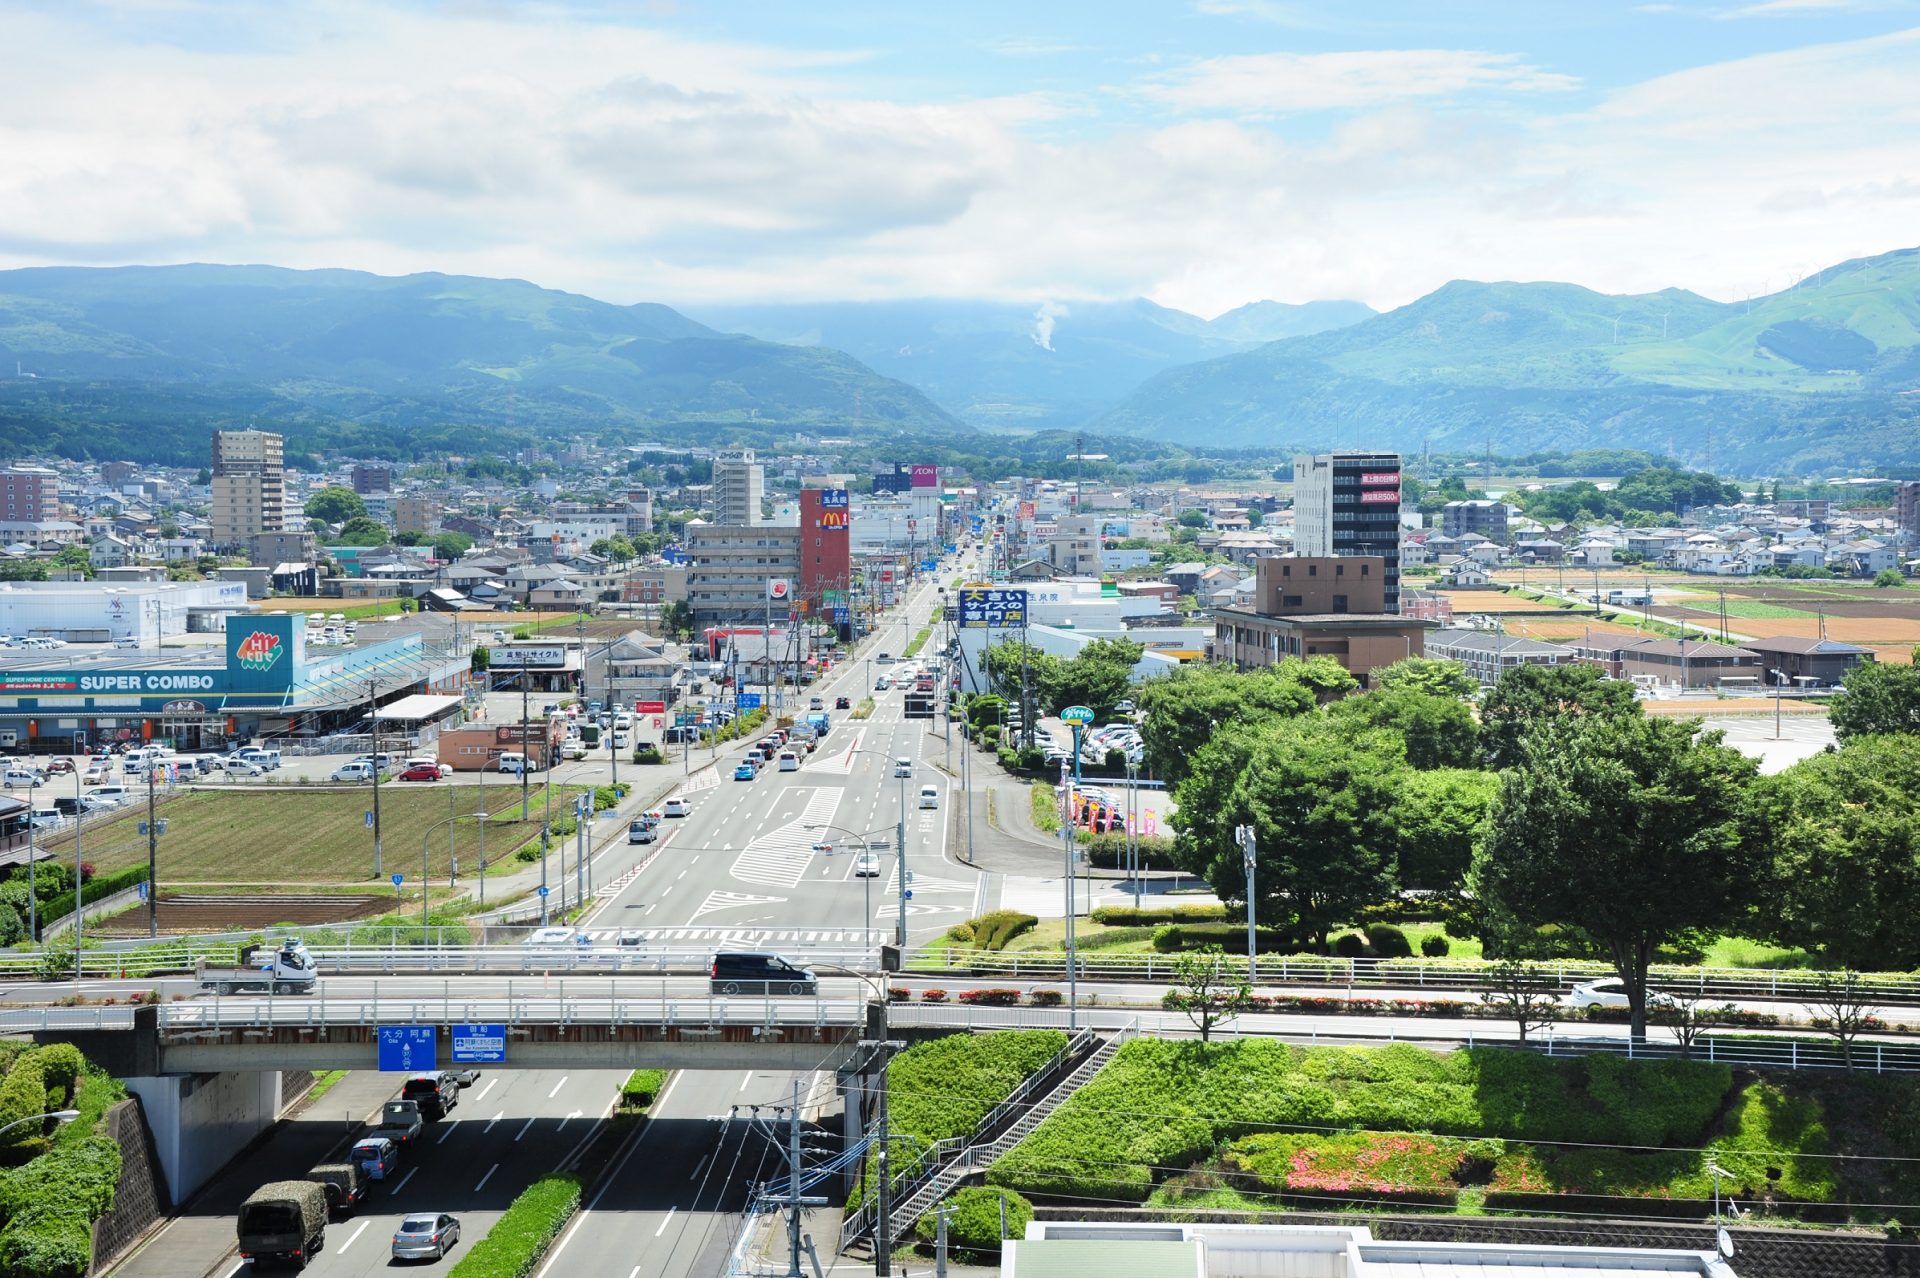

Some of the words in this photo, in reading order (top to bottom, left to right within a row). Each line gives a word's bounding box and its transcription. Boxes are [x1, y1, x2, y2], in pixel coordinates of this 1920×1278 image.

[823, 496, 847, 504] 玉泉院
[965, 590, 1022, 602] 大きい
[965, 601, 1022, 610] サイズの
[965, 611, 1022, 621] 専門店
[251, 639, 269, 651] HI
[247, 650, 273, 662] ヒロセ
[80, 676, 141, 690] SUPER
[146, 675, 213, 690] COMBO
[1065, 708, 1092, 720] ダイナム
[383, 1030, 403, 1038] 大分
